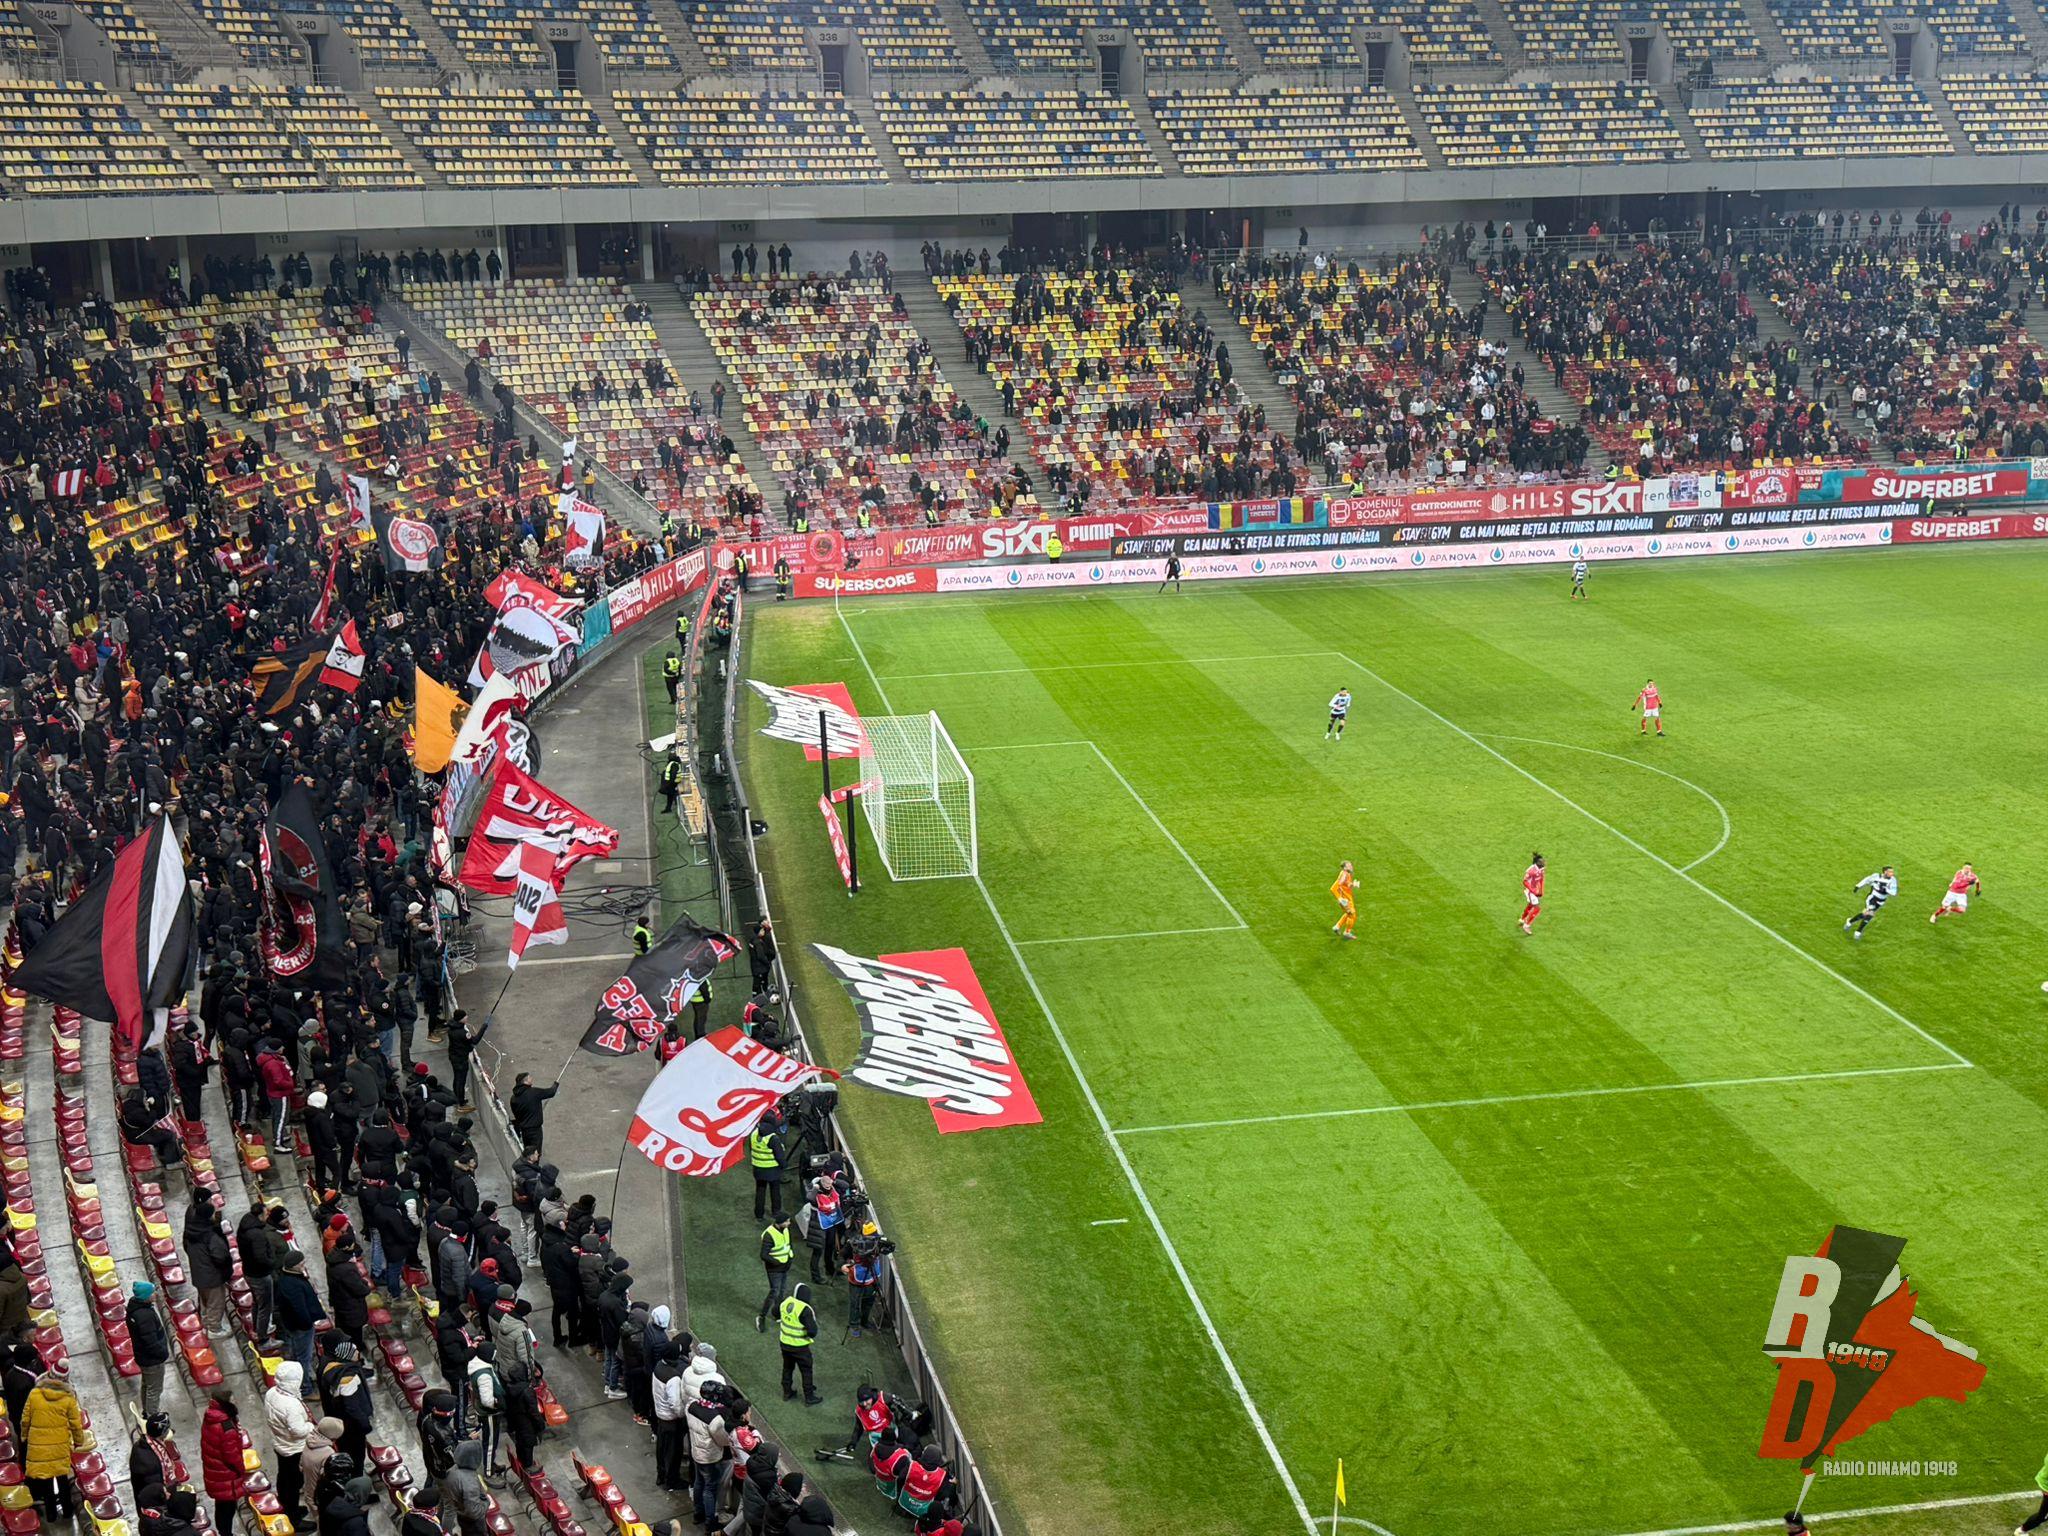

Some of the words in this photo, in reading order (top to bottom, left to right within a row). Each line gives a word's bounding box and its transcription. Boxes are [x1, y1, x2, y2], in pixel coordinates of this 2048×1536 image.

[37, 9, 57, 21] 342
[296, 20, 317, 30] 340
[549, 27, 569, 37] 338
[1628, 27, 1646, 35] 330
[819, 33, 838, 42] 336
[1098, 34, 1115, 43] 334
[1365, 32, 1382, 41] 332
[731, 223, 749, 232] 117
[1871, 472, 1997, 499] SUPERBET
[1351, 498, 1404, 511] DOMENIUL
[1411, 499, 1482, 511] CENTROKINETIC
[1512, 490, 1564, 510] HILS
[1356, 508, 1399, 519] BOGDAN
[1731, 513, 1748, 525] CEA
[1749, 512, 1766, 524] MAI
[1767, 511, 1790, 523] MARE
[1818, 508, 1830, 520] DE
[1830, 506, 1863, 519] FITNESS
[1863, 505, 1880, 518] DIN
[1069, 523, 1115, 542] PUMA
[1459, 526, 1475, 539] CEA
[1477, 525, 1495, 537] MAI
[1496, 524, 1521, 537] MARE
[1549, 522, 1561, 534] DE
[1561, 520, 1595, 533] FITNESS
[1596, 519, 1613, 532] DIN
[1910, 518, 2002, 537] SUPERBET
[1183, 539, 1200, 551] CEA
[1202, 538, 1219, 550] MAI
[1274, 535, 1286, 547] DE
[1287, 533, 1321, 546] FITNESS
[1322, 533, 1339, 545] DIN
[1743, 538, 1762, 546] APA
[1762, 537, 1790, 545] NOVA
[1820, 534, 1838, 542] APA
[1839, 532, 1867, 541] NOVA
[1587, 546, 1605, 554] APA
[1606, 545, 1634, 553] NOVA
[1666, 543, 1684, 551] APA
[1685, 541, 1713, 549] NOVA
[1429, 554, 1448, 562] APA
[1449, 553, 1477, 561] NOVA
[1509, 550, 1527, 558] APA
[1528, 548, 1556, 557] NOVA
[1270, 561, 1288, 569] APA
[1289, 560, 1318, 568] NOVA
[1350, 557, 1368, 566] APA
[1370, 556, 1398, 565] NOVA
[1108, 569, 1127, 577] APA
[1128, 568, 1157, 577] NOVA
[1190, 565, 1209, 573] APA
[1209, 564, 1239, 573] NOVA
[814, 572, 917, 591] SUPERSCORE
[943, 576, 962, 585] APA
[963, 575, 993, 584] NOVA
[1026, 573, 1045, 582] APA
[1046, 571, 1075, 580] NOVA
[650, 568, 673, 598] HILS
